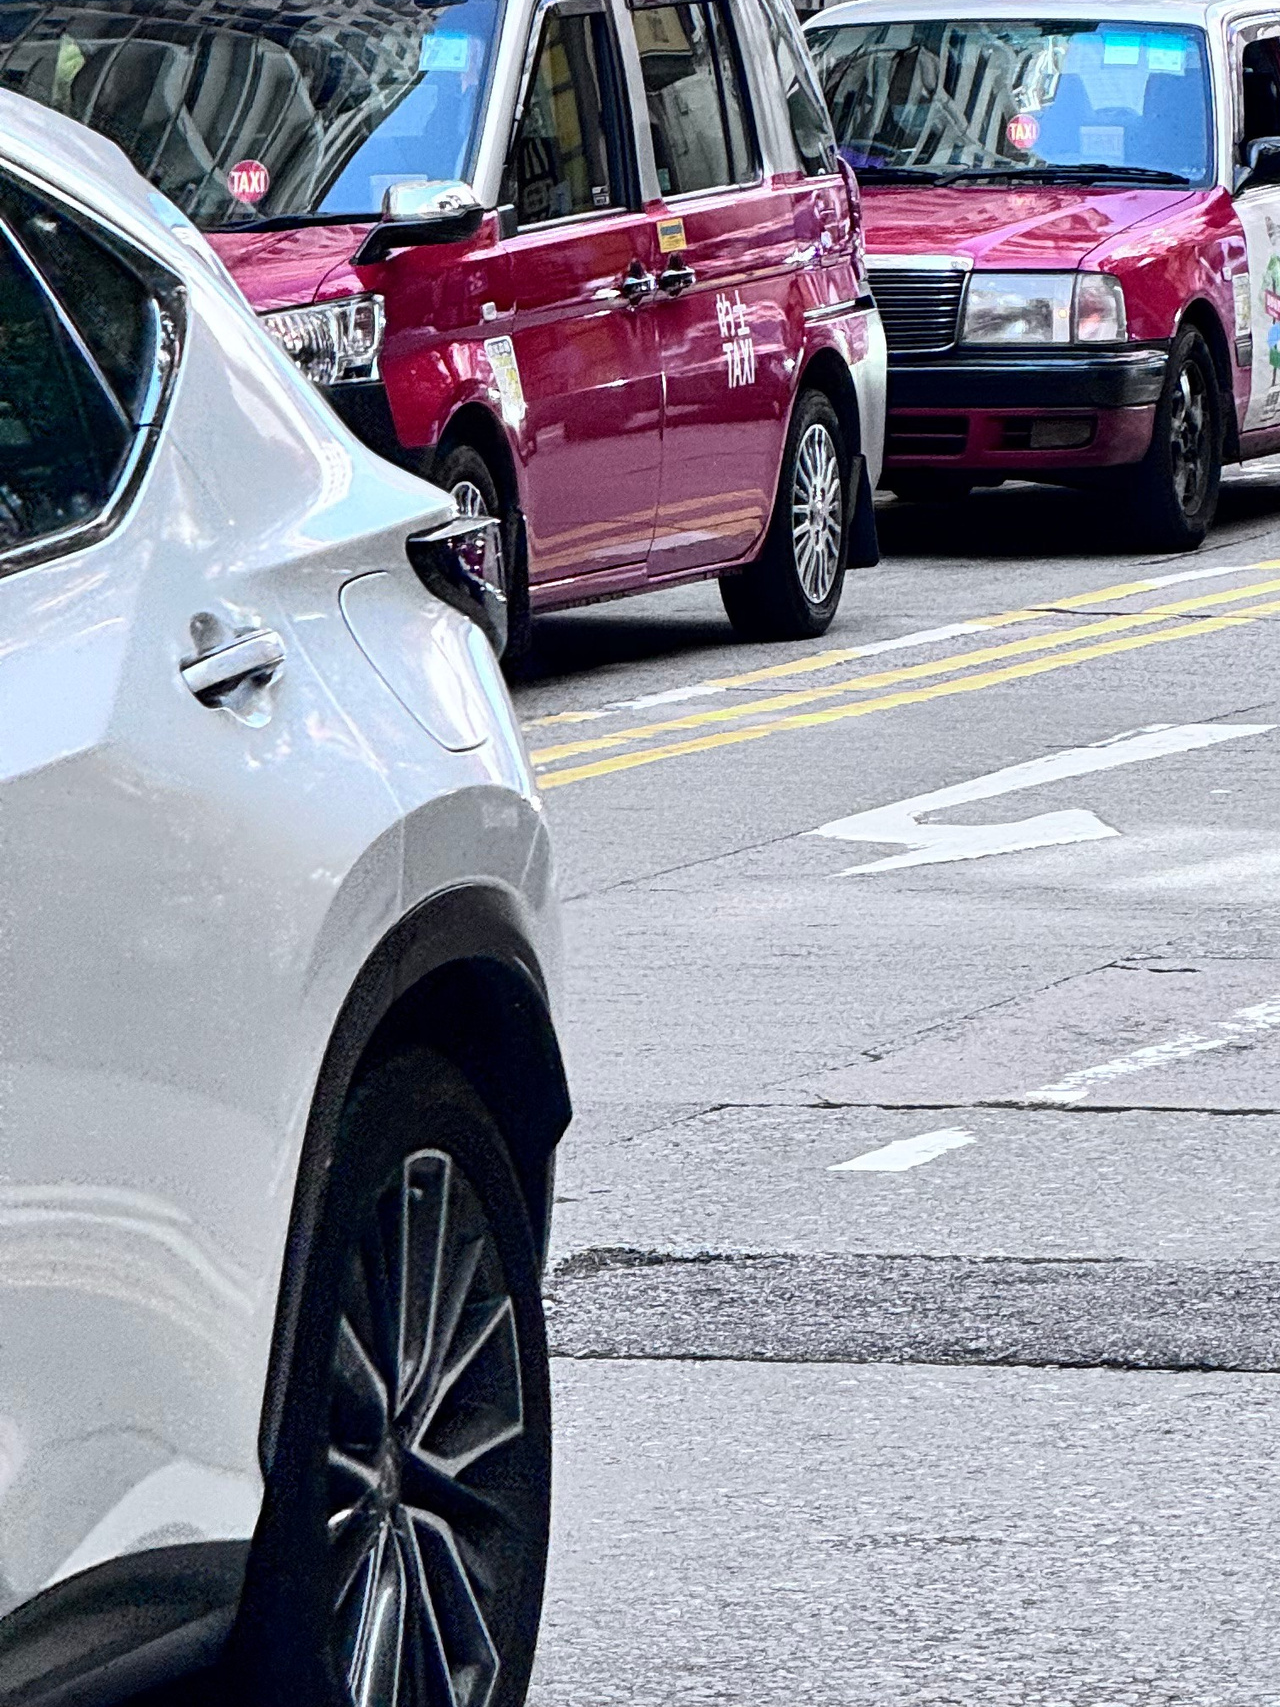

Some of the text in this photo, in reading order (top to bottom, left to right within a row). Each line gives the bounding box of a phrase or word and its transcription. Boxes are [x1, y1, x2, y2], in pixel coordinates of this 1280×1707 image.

[1010, 123, 1037, 141] TAXI
[230, 170, 266, 193] TAXI
[716, 289, 751, 337] 的士
[722, 338, 756, 388] TAXI
